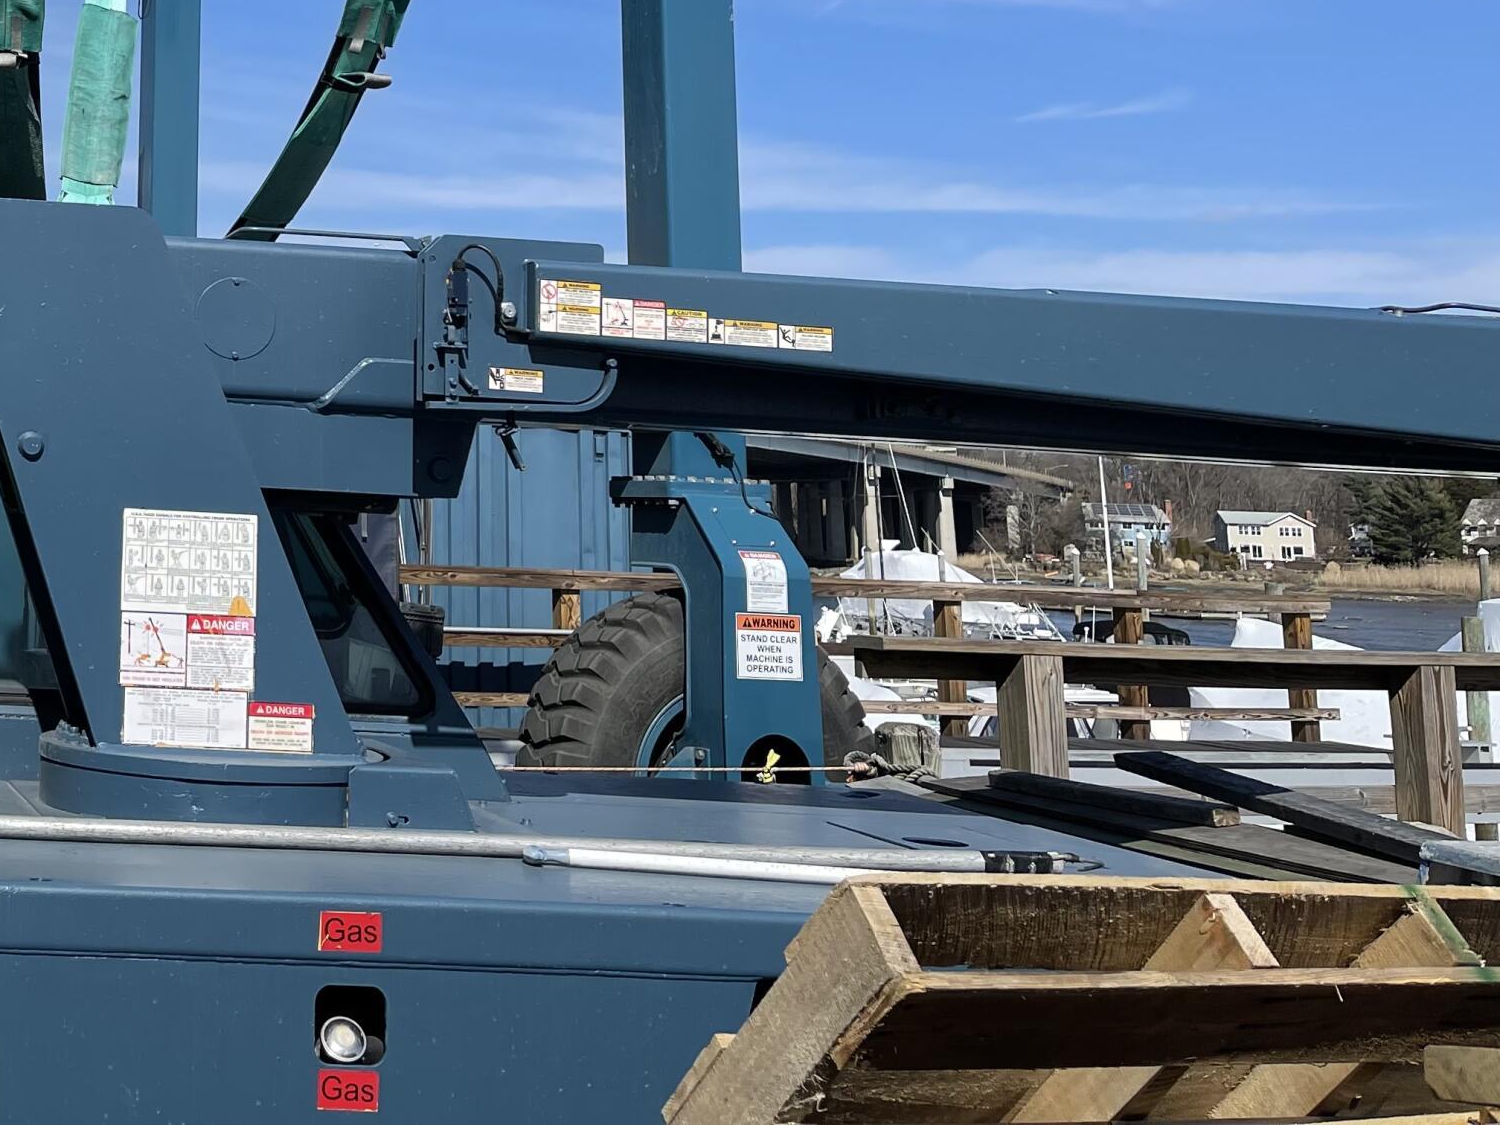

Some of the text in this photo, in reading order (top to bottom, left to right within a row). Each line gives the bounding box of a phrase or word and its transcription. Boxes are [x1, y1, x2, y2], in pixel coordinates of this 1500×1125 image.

[203, 619, 249, 631] DANGER
[752, 617, 796, 630] WARNING
[740, 634, 798, 644] STAND CLEAR
[757, 645, 782, 653] WHEN
[746, 654, 784, 663] MACHINE
[746, 664, 794, 674] OPERATING
[265, 705, 305, 716] DANGER
[324, 917, 378, 944] Gas
[321, 1075, 374, 1103] Gas
